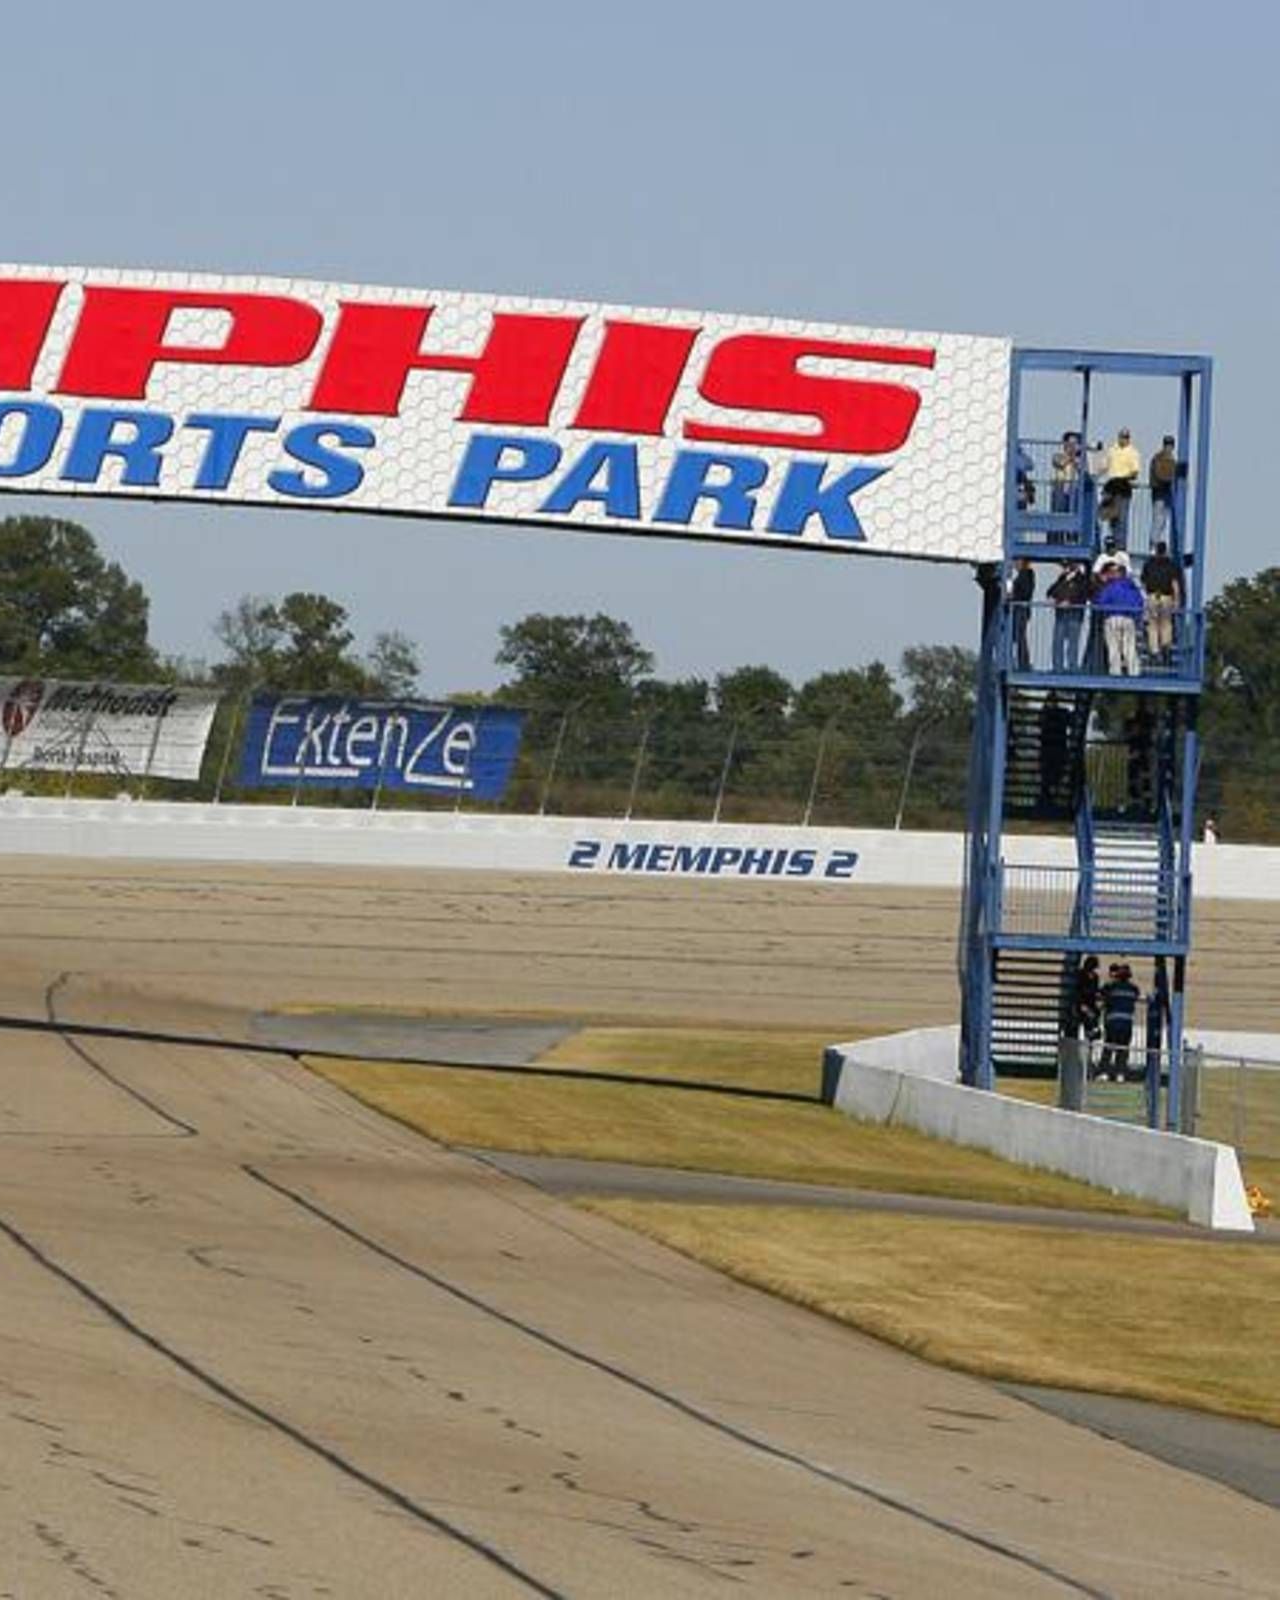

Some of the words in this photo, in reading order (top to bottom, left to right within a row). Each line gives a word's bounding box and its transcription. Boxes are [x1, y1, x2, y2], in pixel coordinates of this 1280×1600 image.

[447, 433, 892, 543] PARK
[568, 840, 601, 869] 2
[608, 842, 818, 877] MEMPHIS
[823, 849, 859, 878] 2
